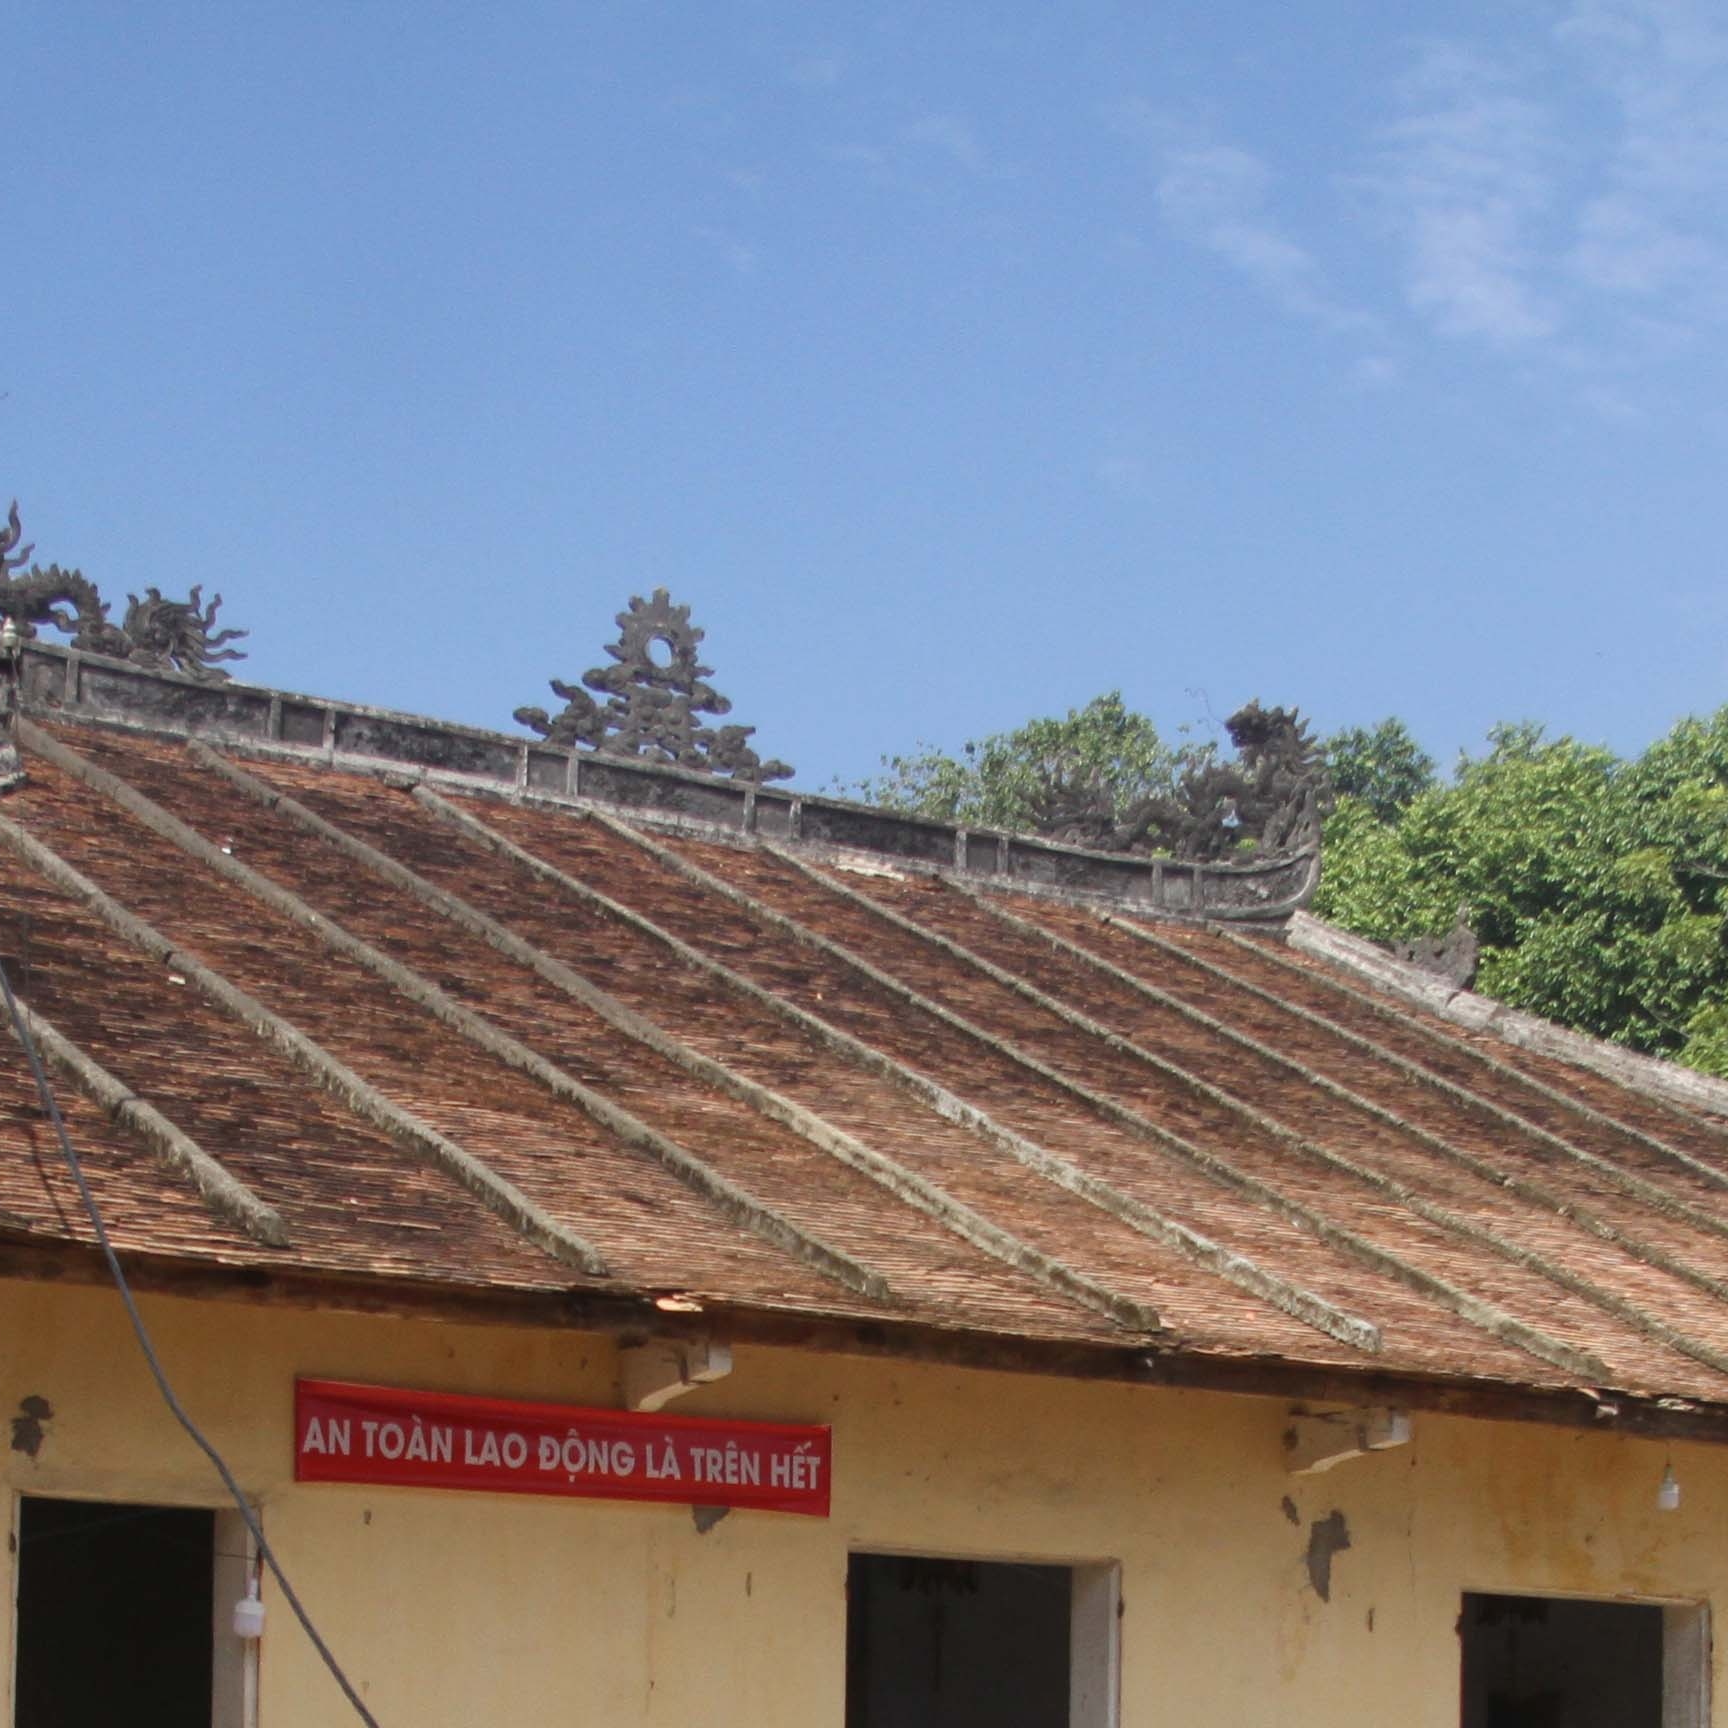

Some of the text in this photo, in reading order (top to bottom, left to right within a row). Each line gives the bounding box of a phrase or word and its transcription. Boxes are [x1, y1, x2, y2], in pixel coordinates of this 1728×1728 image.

[302, 1414, 821, 1489] AN TOÀN LAO ĐỘNG LÀ TRÊN HẾT
